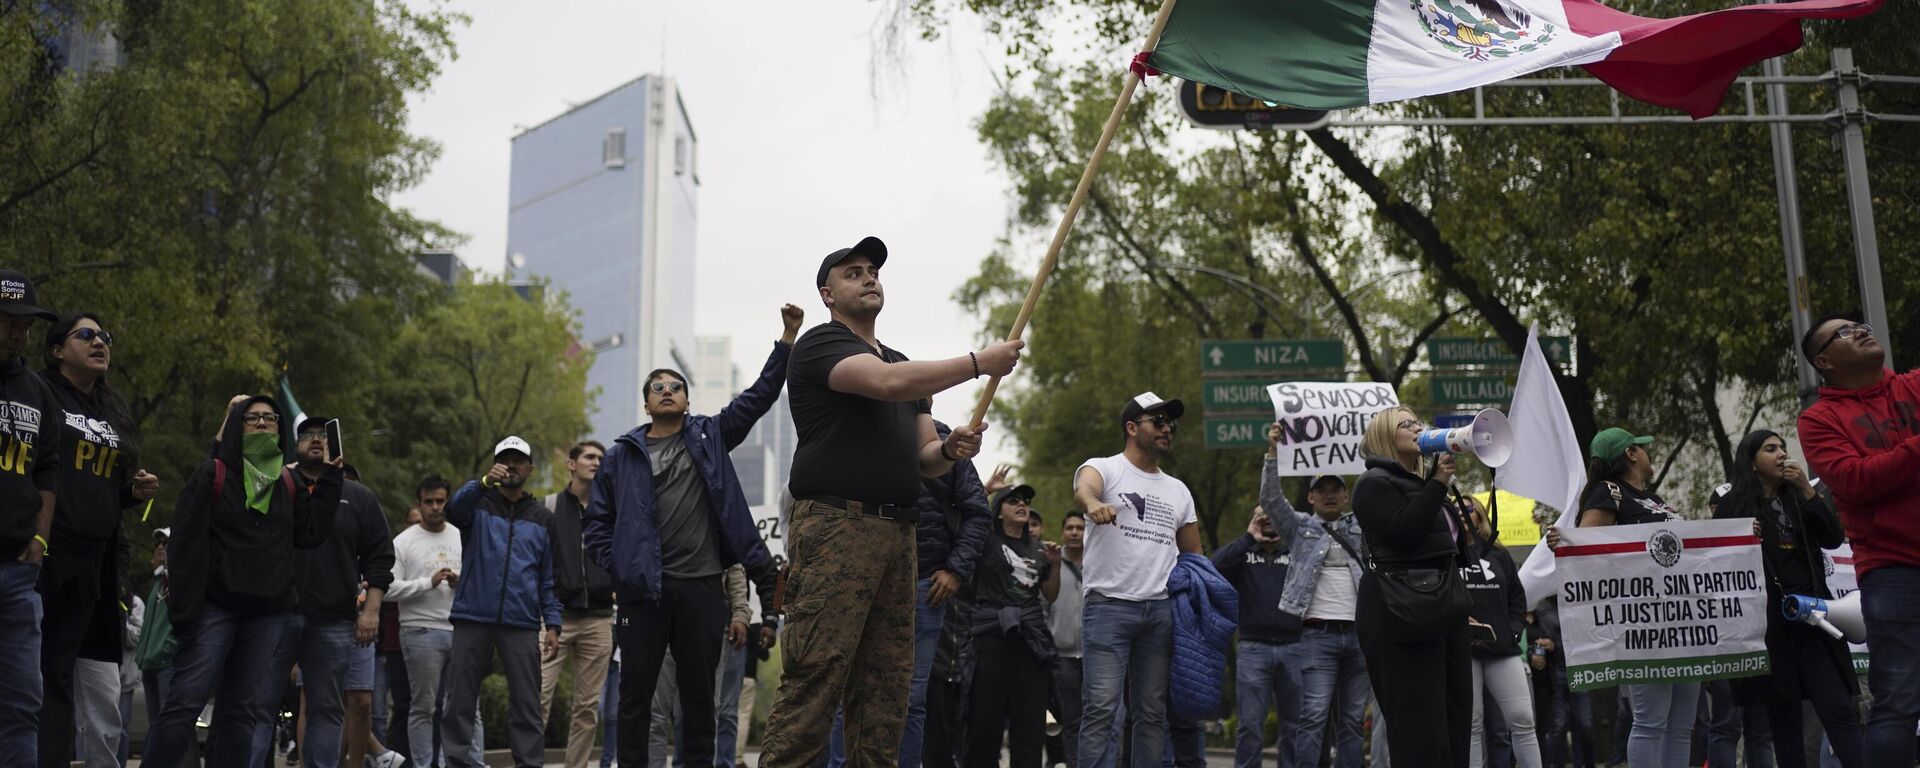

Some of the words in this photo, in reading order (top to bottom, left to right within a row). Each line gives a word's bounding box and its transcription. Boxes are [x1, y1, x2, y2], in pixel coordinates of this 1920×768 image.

[1, 280, 25, 288] #Todos
[1, 286, 25, 294] Somos
[1255, 347, 1309, 364] NIZA
[1217, 423, 1253, 441] SAN
[1279, 415, 1324, 446] NO
[75, 440, 120, 479] PJF
[1564, 581, 1593, 602] SIN
[1598, 577, 1660, 599] COLOR,
[1664, 574, 1690, 596] SIN
[1693, 570, 1762, 593] PARTIDO,
[1593, 604, 1614, 626] LA
[1620, 601, 1693, 625] JUSTICIA
[1697, 599, 1718, 620] SE
[1722, 597, 1743, 618] HA
[1625, 625, 1718, 650] IMPARTIDO
